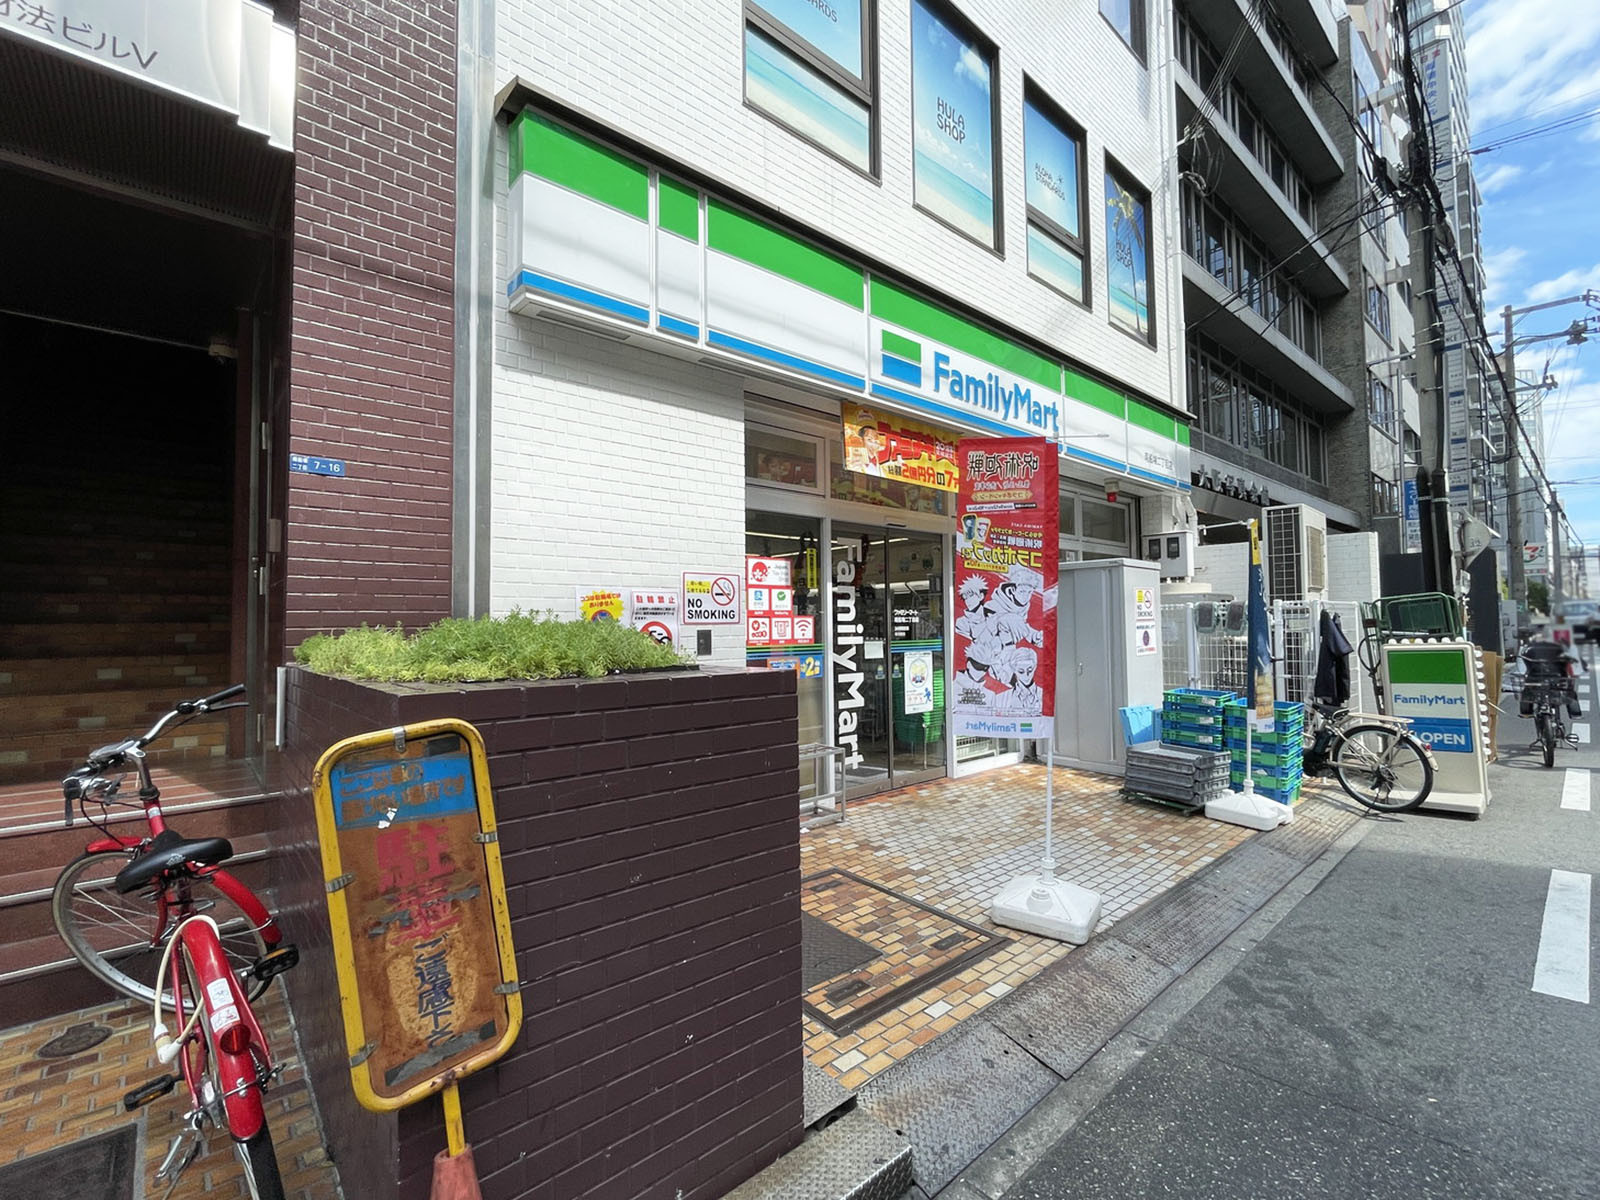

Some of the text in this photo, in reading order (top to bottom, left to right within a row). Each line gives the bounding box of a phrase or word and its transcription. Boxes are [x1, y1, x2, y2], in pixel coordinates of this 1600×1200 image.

[807, 0, 838, 23] ARDS
[937, 96, 965, 131] HULA
[937, 113, 966, 144] SHOP
[933, 350, 1060, 432] FamilyMart
[313, 460, 341, 473] 7-16
[687, 598, 703, 609] NO
[687, 609, 736, 620] SMOKING
[832, 536, 865, 770] FamilyMart
[1393, 693, 1466, 707] FamilyMart
[1420, 731, 1466, 746] OPEN
